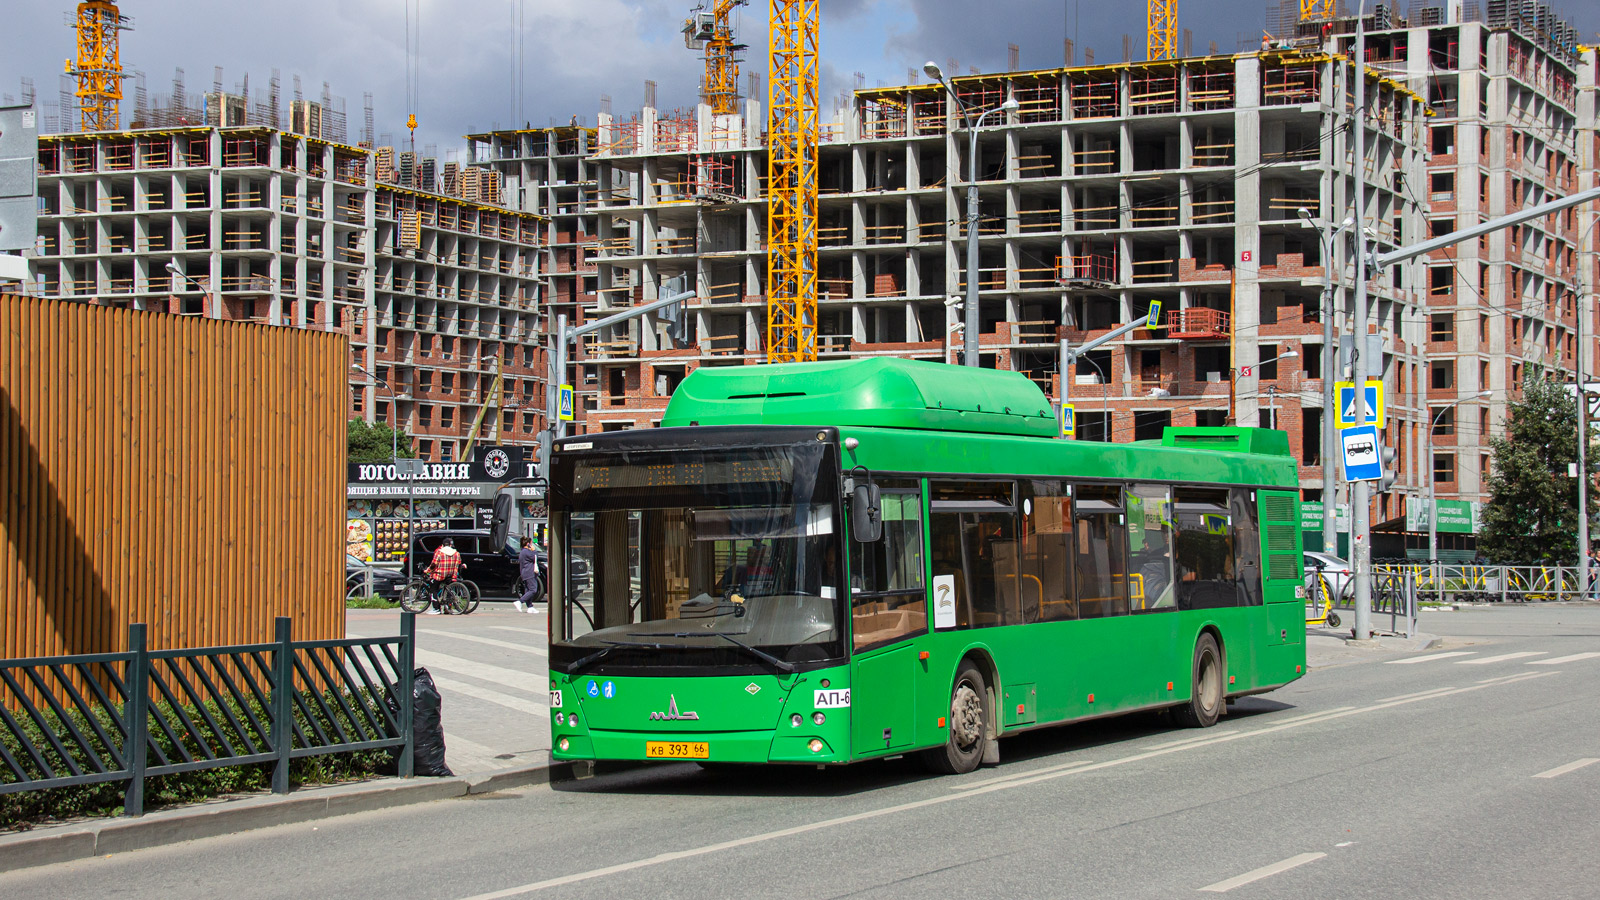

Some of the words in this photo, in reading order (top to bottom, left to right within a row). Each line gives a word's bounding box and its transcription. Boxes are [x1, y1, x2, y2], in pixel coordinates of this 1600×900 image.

[1243, 252, 1249, 261] 5
[439, 486, 481, 495] БУРГЕРЫ
[816, 690, 850, 706] АП-6
[668, 744, 688, 756] 393
[694, 743, 705, 753] 66
